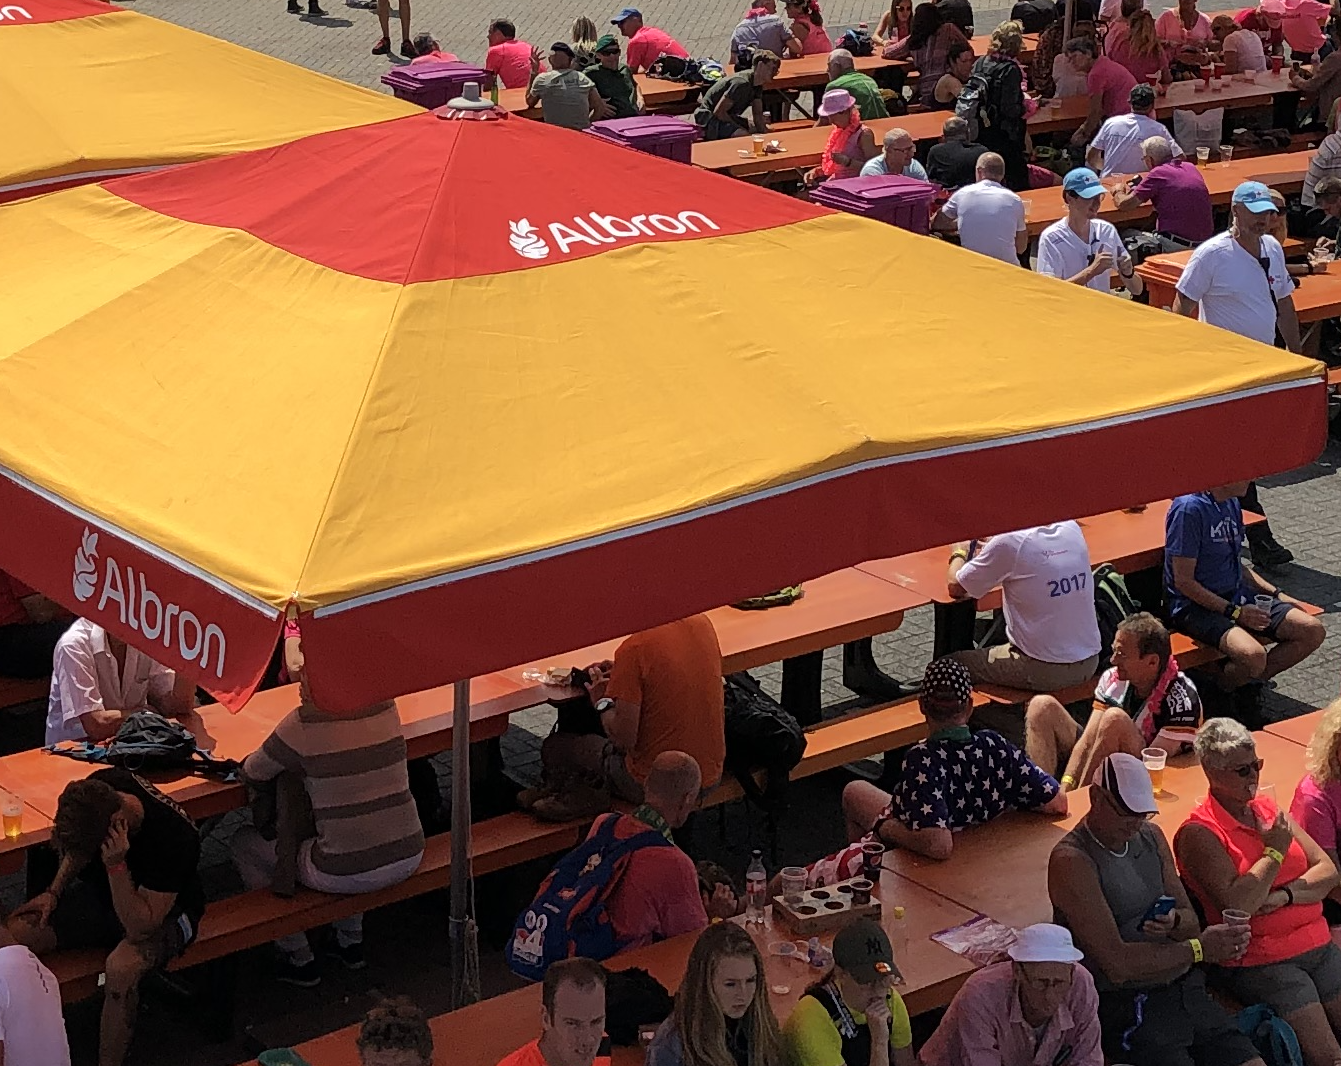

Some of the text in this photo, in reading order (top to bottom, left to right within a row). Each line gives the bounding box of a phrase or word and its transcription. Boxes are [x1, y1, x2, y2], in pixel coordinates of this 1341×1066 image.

[549, 207, 721, 255] Albron
[1047, 572, 1087, 598] 2017
[97, 556, 227, 680] Albron
